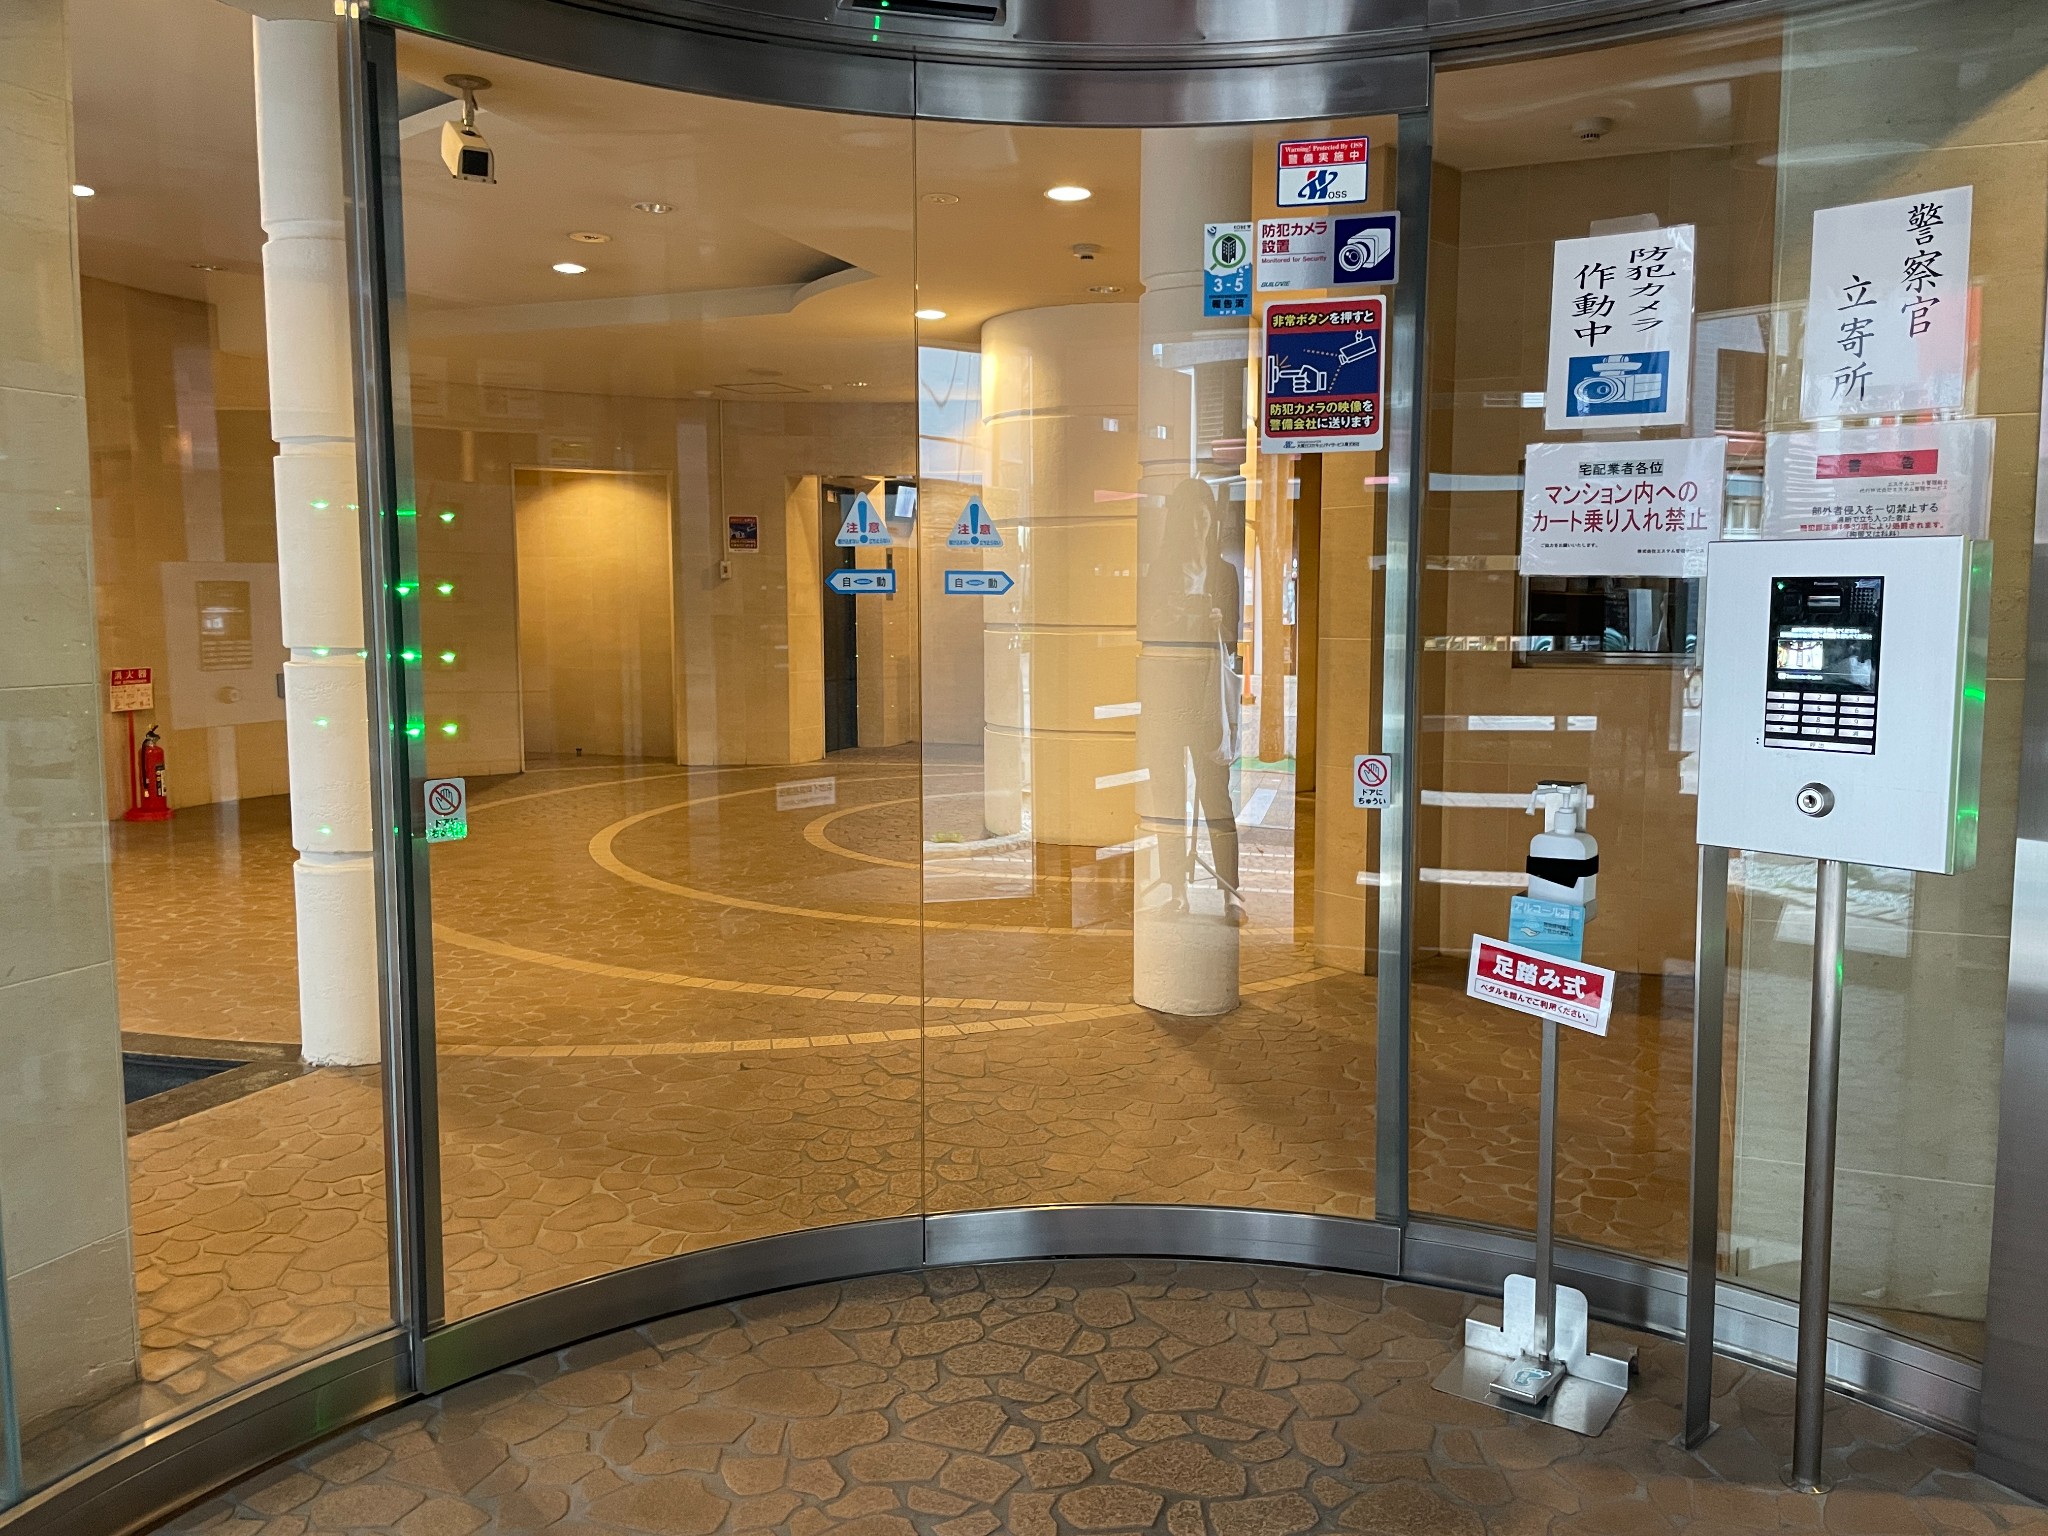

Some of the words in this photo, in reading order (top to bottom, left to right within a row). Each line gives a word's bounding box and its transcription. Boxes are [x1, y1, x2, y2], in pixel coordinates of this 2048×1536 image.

[1313, 144, 1339, 152] Protected
[1341, 143, 1348, 151] By
[1288, 150, 1360, 165] 警備実施中
[1262, 221, 1328, 238] 防犯カメラ
[1262, 239, 1290, 254] 設置
[1302, 255, 1327, 263] Security
[1901, 202, 1944, 339] 警察官
[1625, 246, 1676, 333] 防犯カメラ
[1572, 262, 1617, 348] 作動中
[1272, 310, 1374, 328] 非常ボタンを押すと
[1832, 274, 1877, 401] 立寄所
[1270, 400, 1373, 416] 防犯カメラの映像を
[1270, 415, 1374, 431] 警備会社に送ります
[1579, 461, 1664, 476] 宅配業者各位
[1545, 480, 1698, 505] マンション内への
[1812, 503, 1939, 515] 部外者侵入を一切禁止する
[1532, 507, 1708, 533] カート乗り入れ禁止
[1358, 797, 1386, 805] ちゅうい
[1493, 954, 1587, 999] 足踏み式
